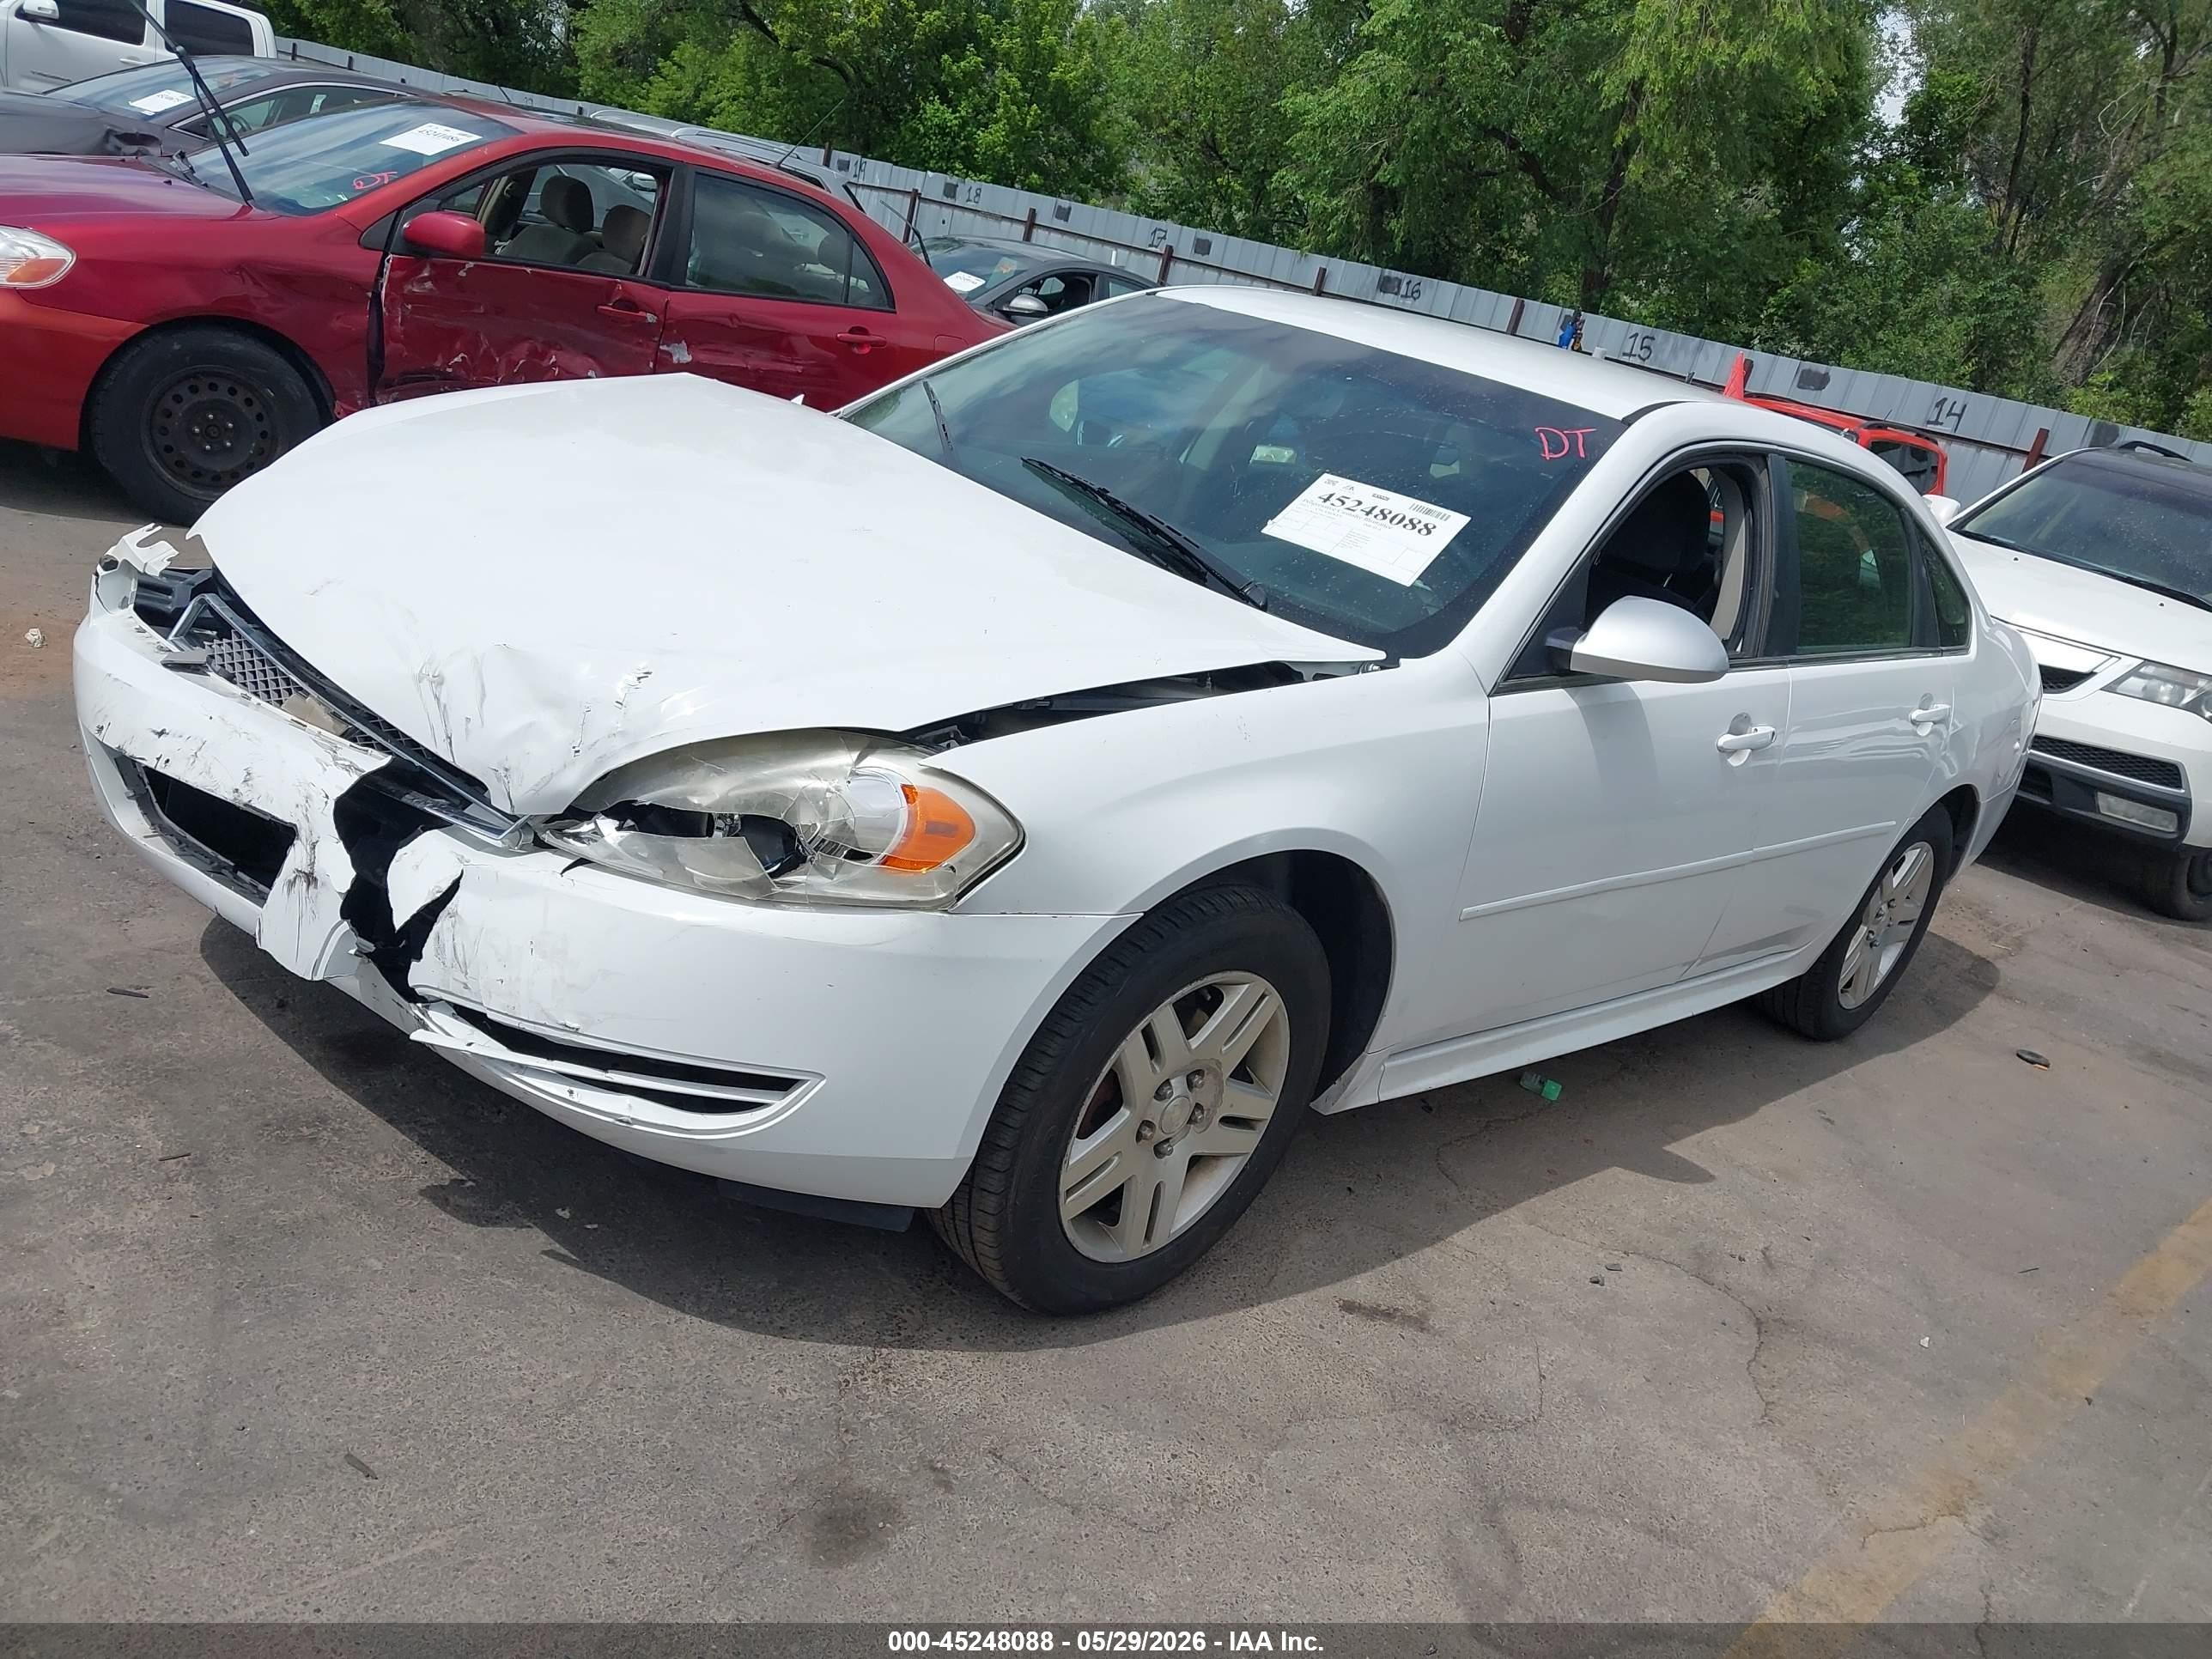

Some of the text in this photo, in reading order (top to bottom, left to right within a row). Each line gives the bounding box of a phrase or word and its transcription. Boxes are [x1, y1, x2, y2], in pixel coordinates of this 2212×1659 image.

[965, 185, 982, 204] 18
[1148, 227, 1168, 248] 17
[1401, 280, 1422, 301] 16
[1622, 332, 1656, 362] 15
[1926, 397, 1967, 433] 14
[1534, 426, 1597, 460] DT
[1317, 491, 1437, 537] 45248088
